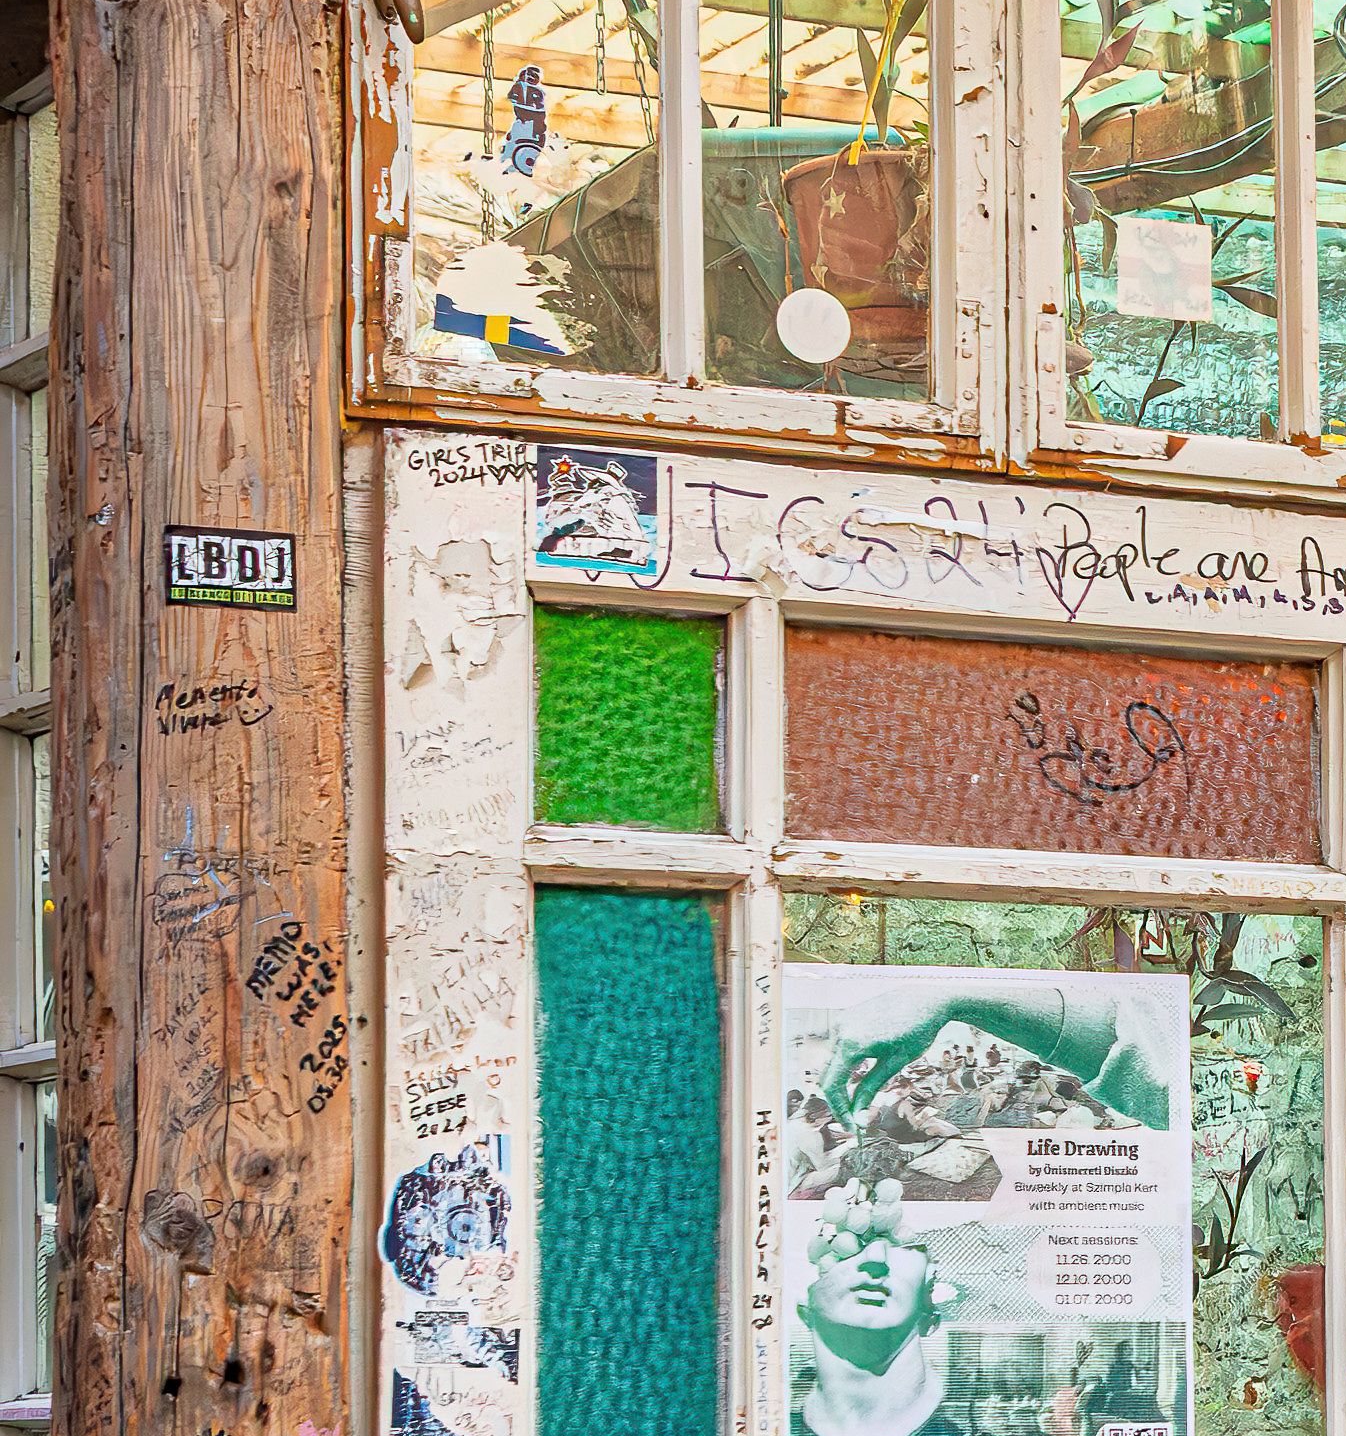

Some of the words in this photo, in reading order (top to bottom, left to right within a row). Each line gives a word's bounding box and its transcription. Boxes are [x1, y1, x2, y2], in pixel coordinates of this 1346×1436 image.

[408, 446, 470, 472] GIRLS
[430, 465, 489, 487] 2024
[1027, 1139, 1060, 1156] Life
[1064, 1139, 1139, 1161] Drawing
[1071, 1182, 1082, 1193] at
[1085, 1181, 1132, 1195] Szimpla
[1029, 1201, 1055, 1212] with
[1058, 1201, 1107, 1212] ambient
[1109, 1201, 1144, 1212] music
[1048, 1234, 1078, 1246] Next
